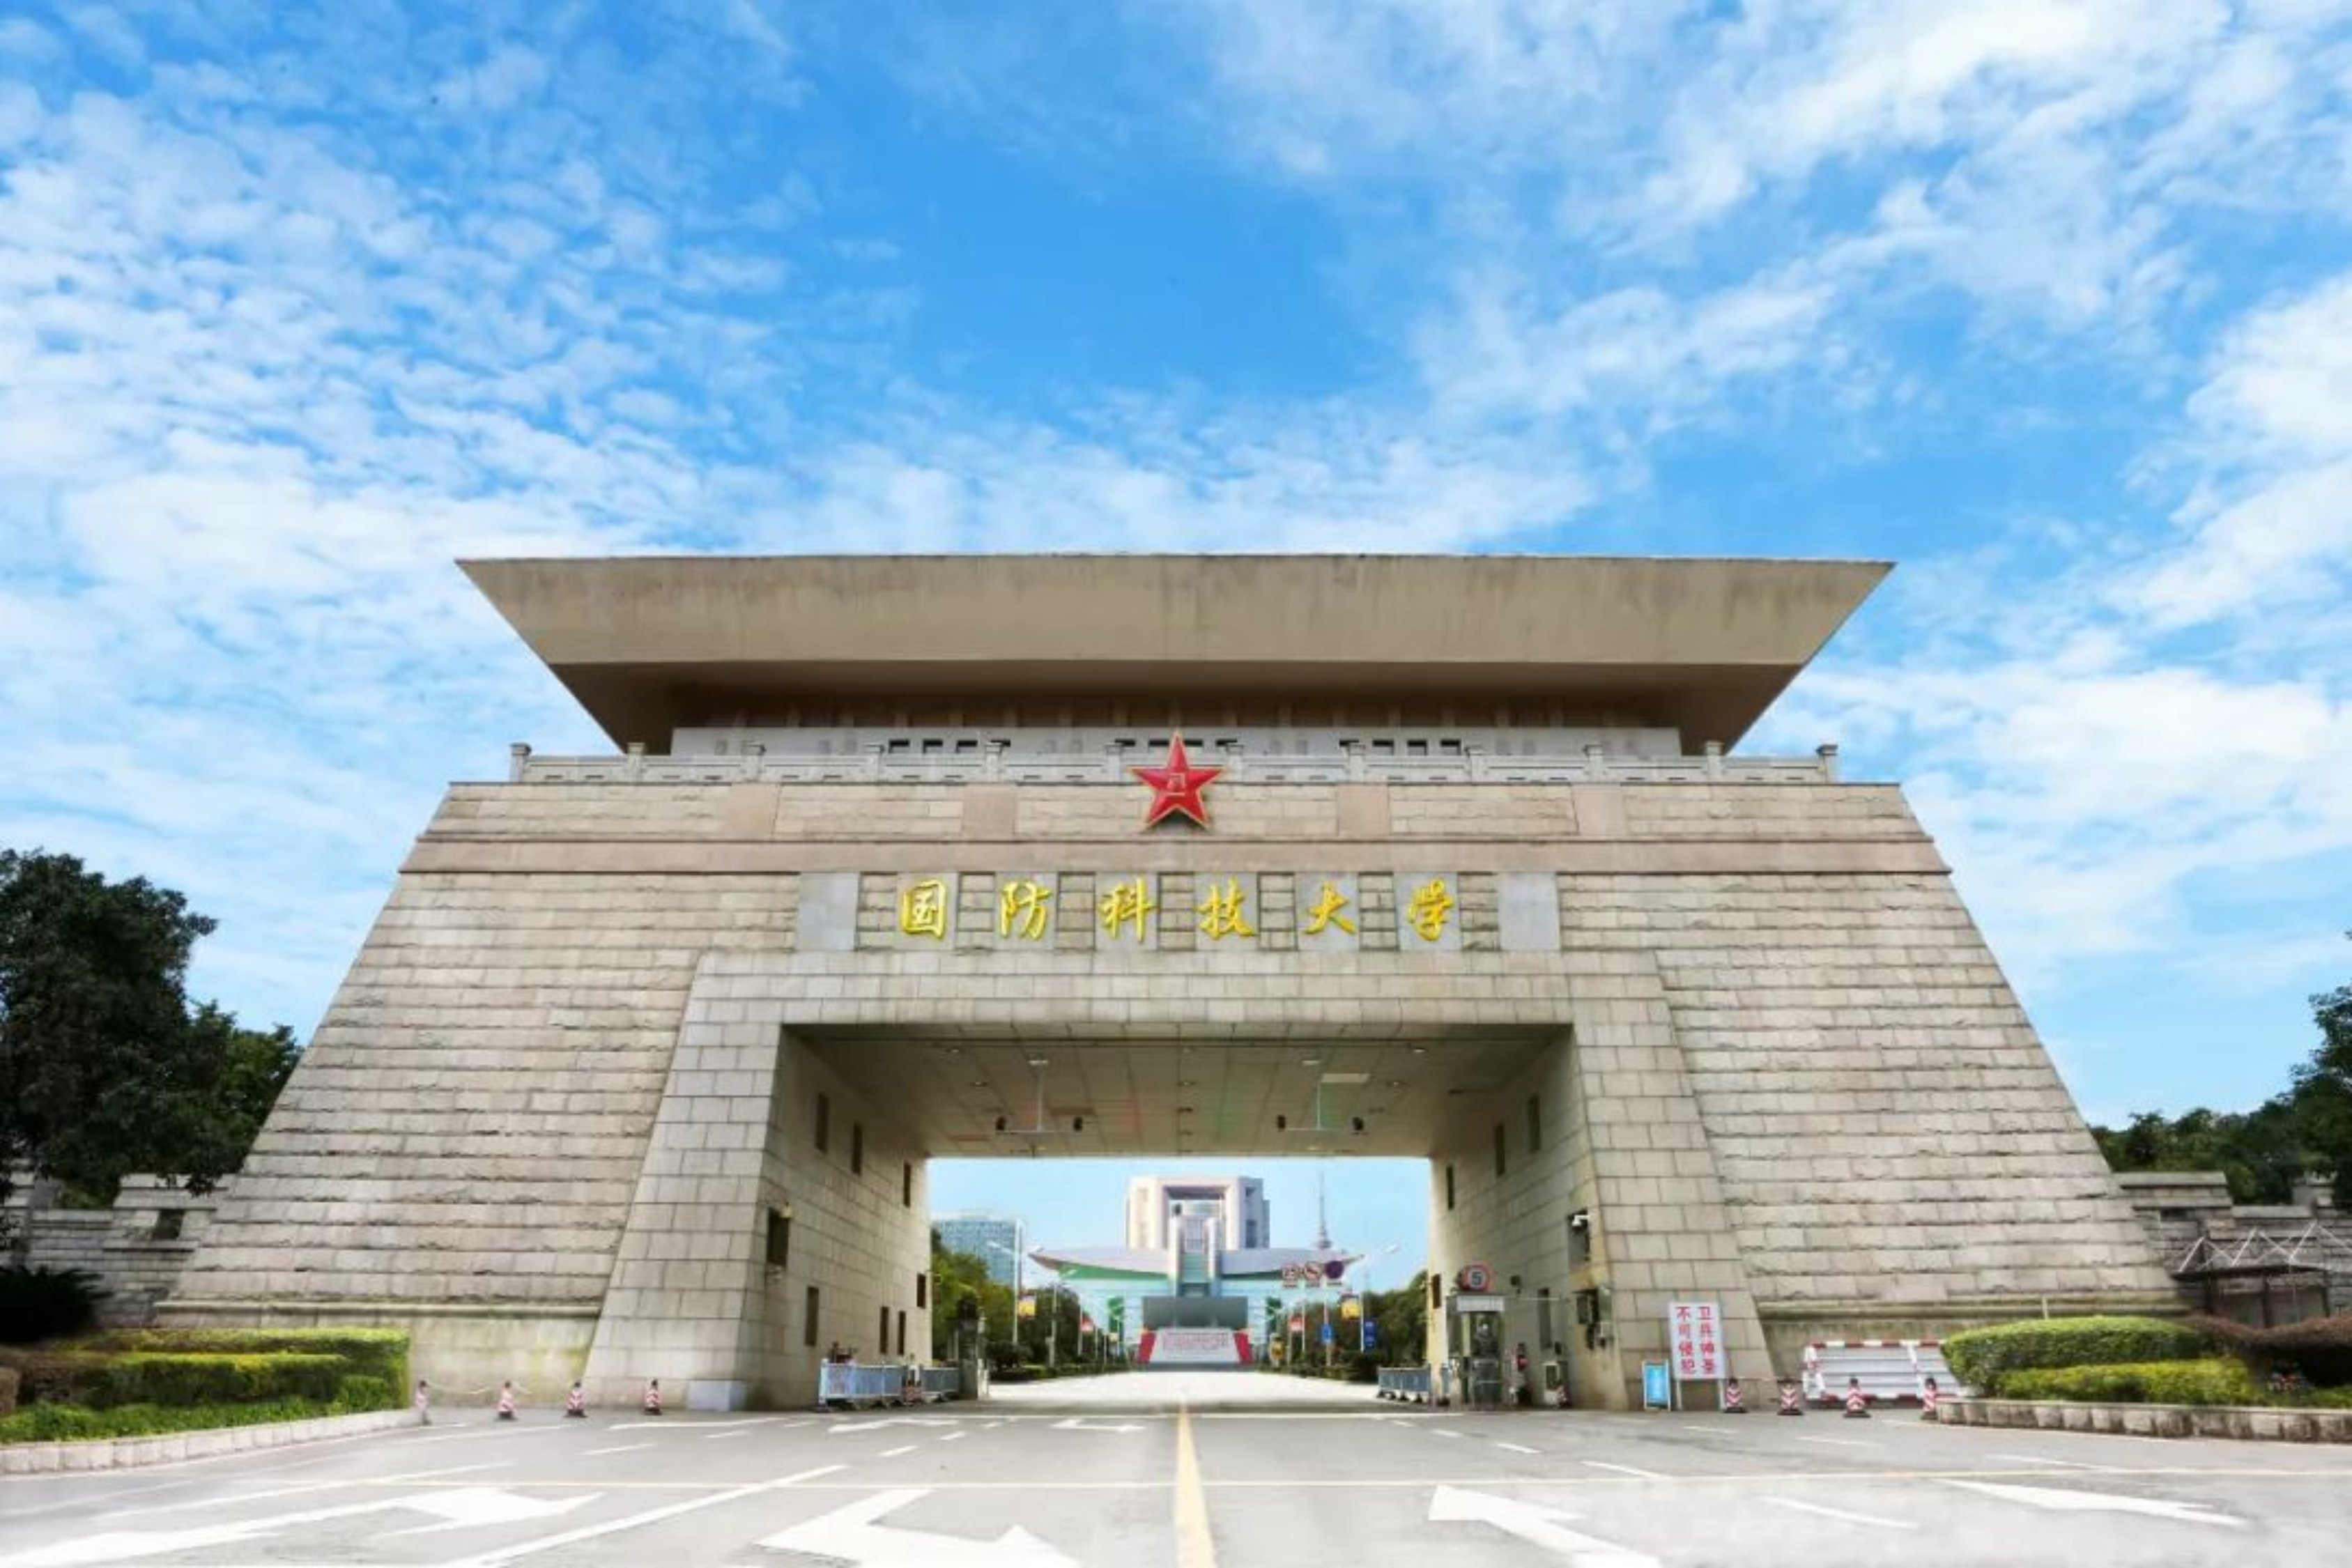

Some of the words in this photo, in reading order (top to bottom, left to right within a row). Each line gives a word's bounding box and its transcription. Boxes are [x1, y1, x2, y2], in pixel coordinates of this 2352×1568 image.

[900, 877, 1454, 941] 国防科技大学
[1471, 1271, 1483, 1286] 5
